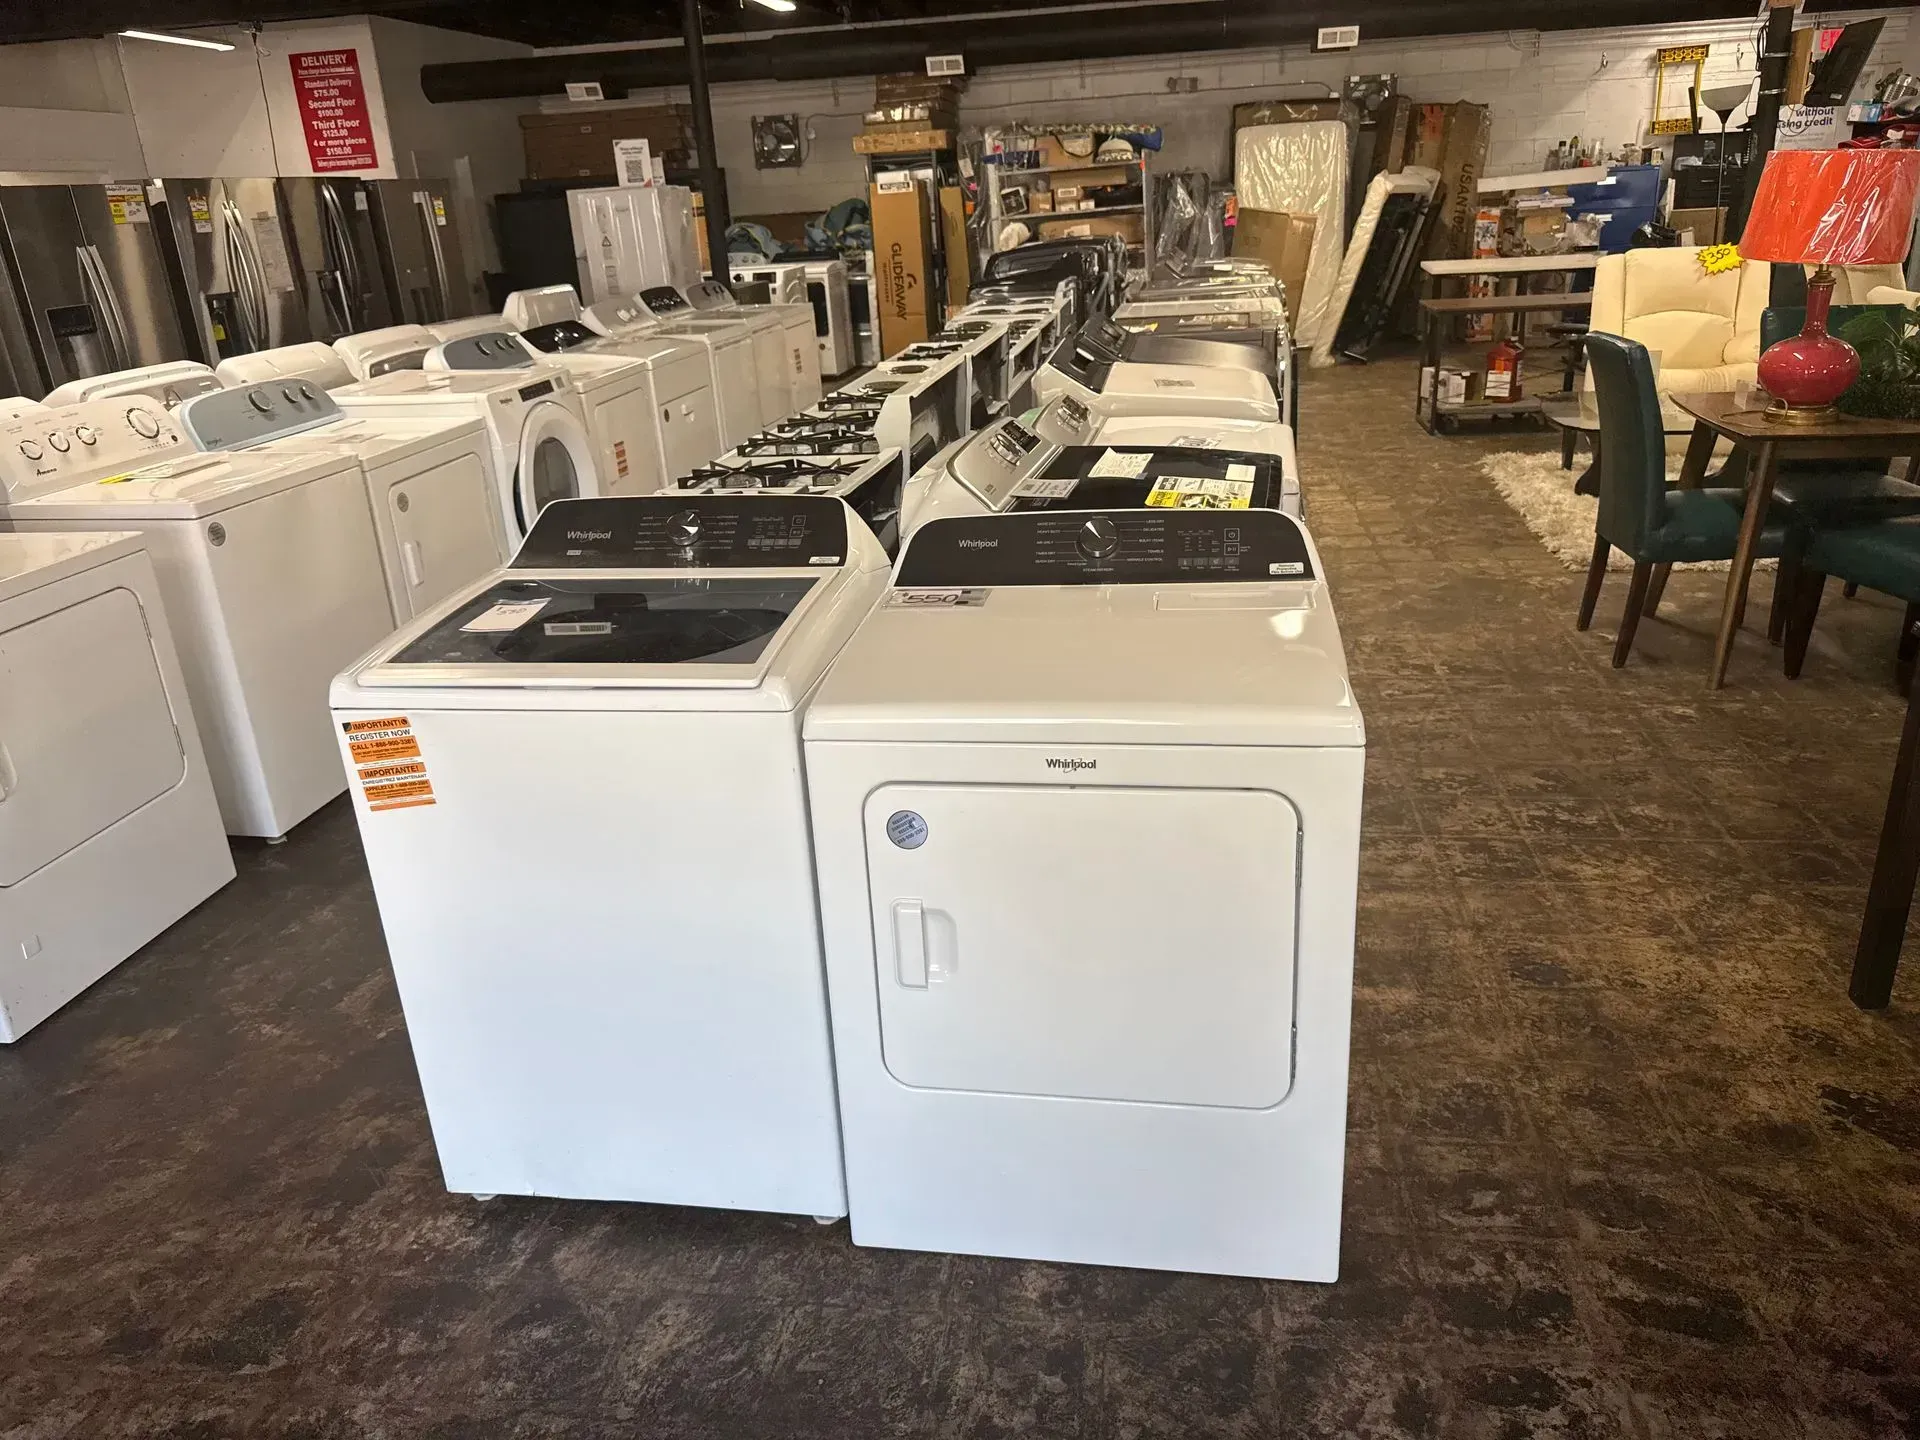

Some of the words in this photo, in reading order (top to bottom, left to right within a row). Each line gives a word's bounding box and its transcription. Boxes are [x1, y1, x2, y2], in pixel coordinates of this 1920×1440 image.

[301, 54, 347, 66] DELIVERY
[304, 79, 328, 88] Standard
[329, 78, 352, 88] Delivery
[314, 89, 339, 97] $75.00
[308, 98, 335, 109] Second
[337, 98, 356, 106] Floor
[318, 108, 343, 118] $100.00
[1795, 107, 1834, 117] without
[312, 120, 335, 130] Third
[337, 119, 360, 128] Floor
[1804, 117, 1833, 127] credit
[322, 129, 348, 138] $125.00
[345, 137, 367, 146] pieces
[326, 146, 352, 155] $150.00
[891, 242, 907, 320] GLIDEAWAY
[567, 530, 611, 541] Whirlpool
[959, 539, 998, 549] Whirlpool
[353, 720, 401, 730] IMPORTANT!
[349, 732, 390, 742] REGISTER
[1046, 758, 1097, 771] Whirlpool
[364, 765, 419, 777] IMPORTANTE!
